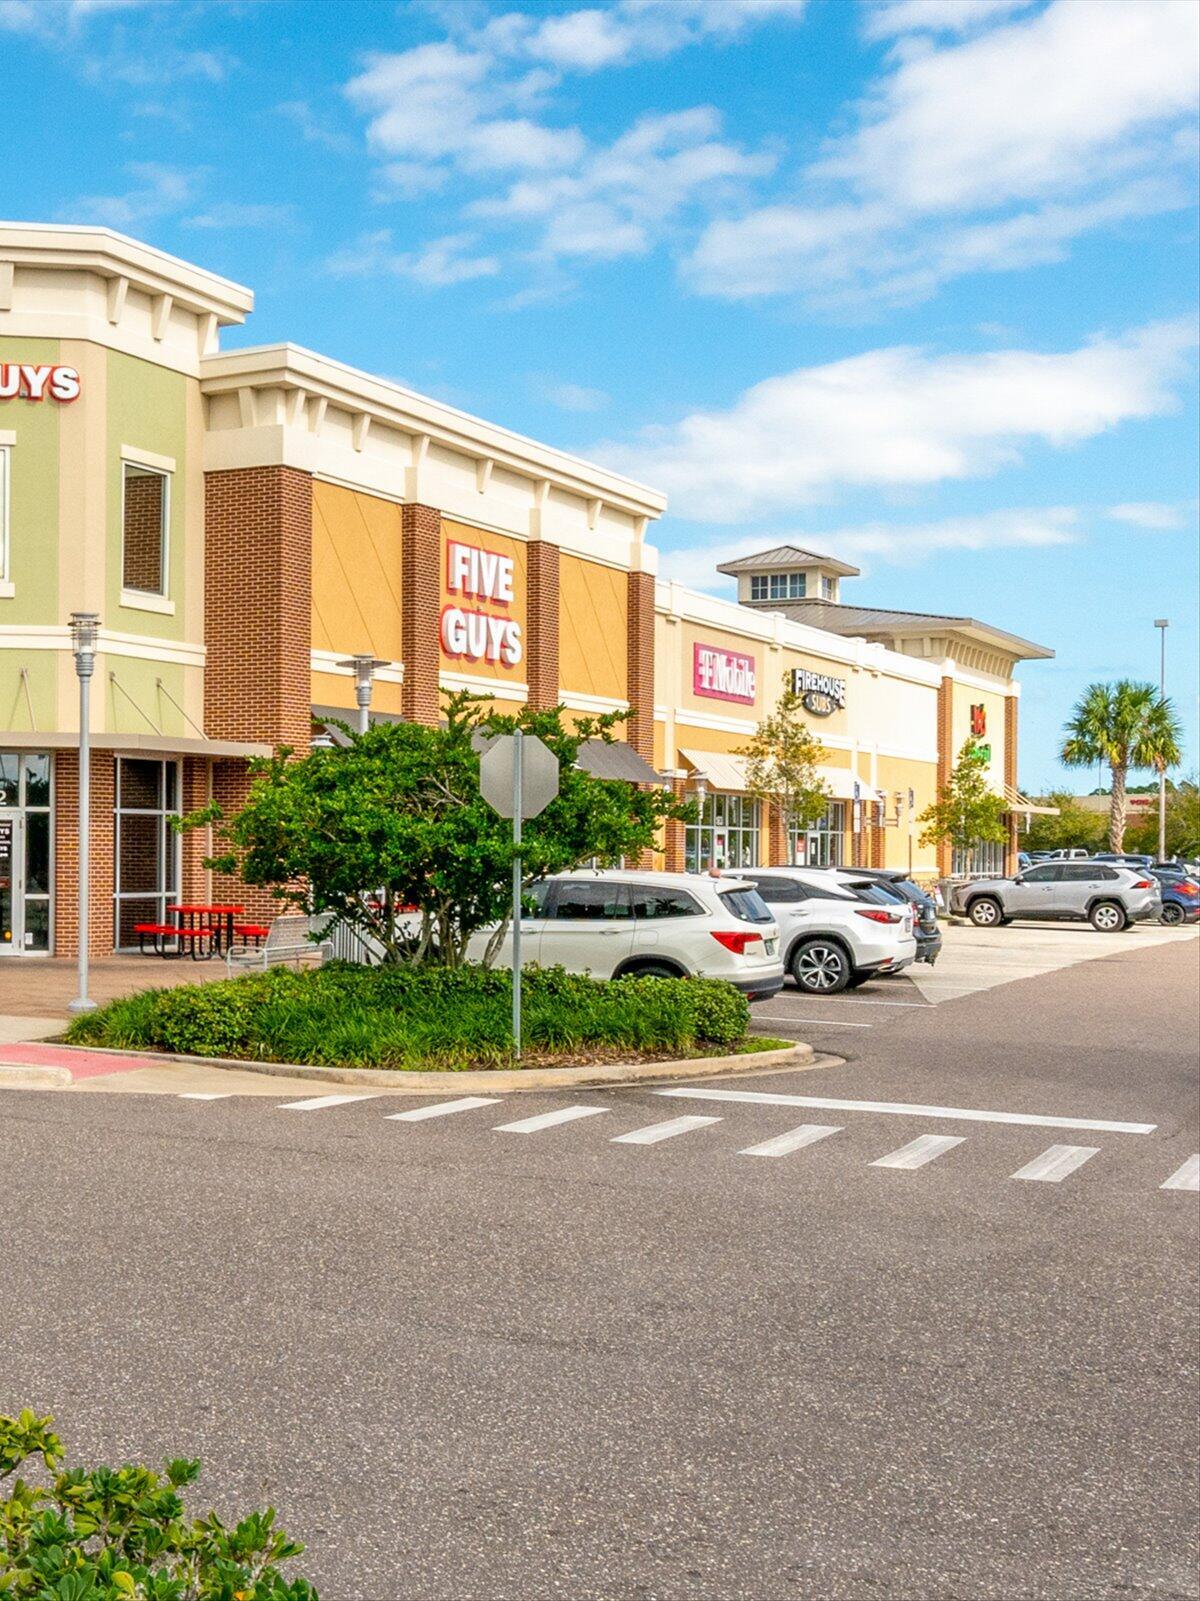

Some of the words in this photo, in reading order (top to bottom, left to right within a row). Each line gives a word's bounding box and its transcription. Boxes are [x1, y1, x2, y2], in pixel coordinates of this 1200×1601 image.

[447, 539, 514, 608] FIVE
[440, 604, 522, 669] GUYS
[791, 668, 846, 707] FIREHOUSE
[811, 694, 831, 713] SUBS
